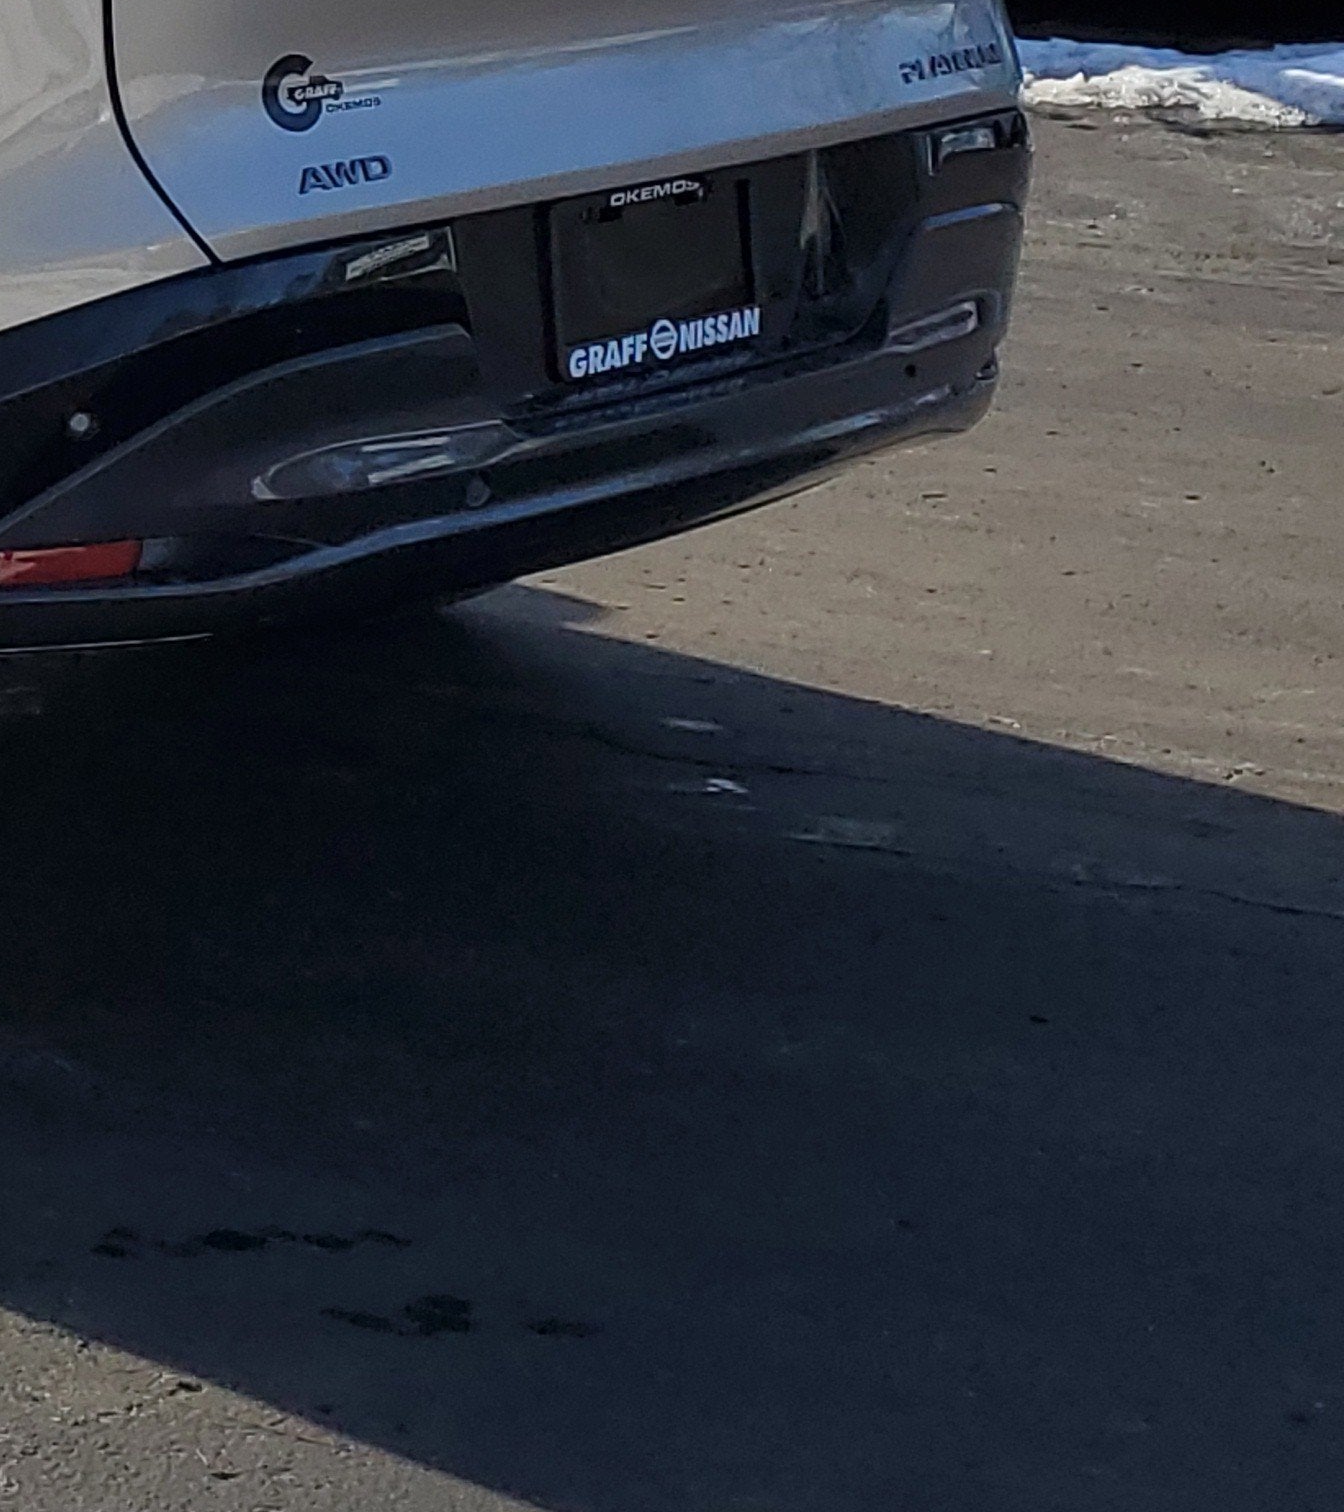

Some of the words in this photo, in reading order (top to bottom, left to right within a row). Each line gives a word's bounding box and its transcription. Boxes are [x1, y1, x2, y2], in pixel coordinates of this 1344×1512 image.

[297, 154, 393, 196] AWD
[569, 333, 648, 378] GRAFF
[679, 307, 761, 353] NISSAN
